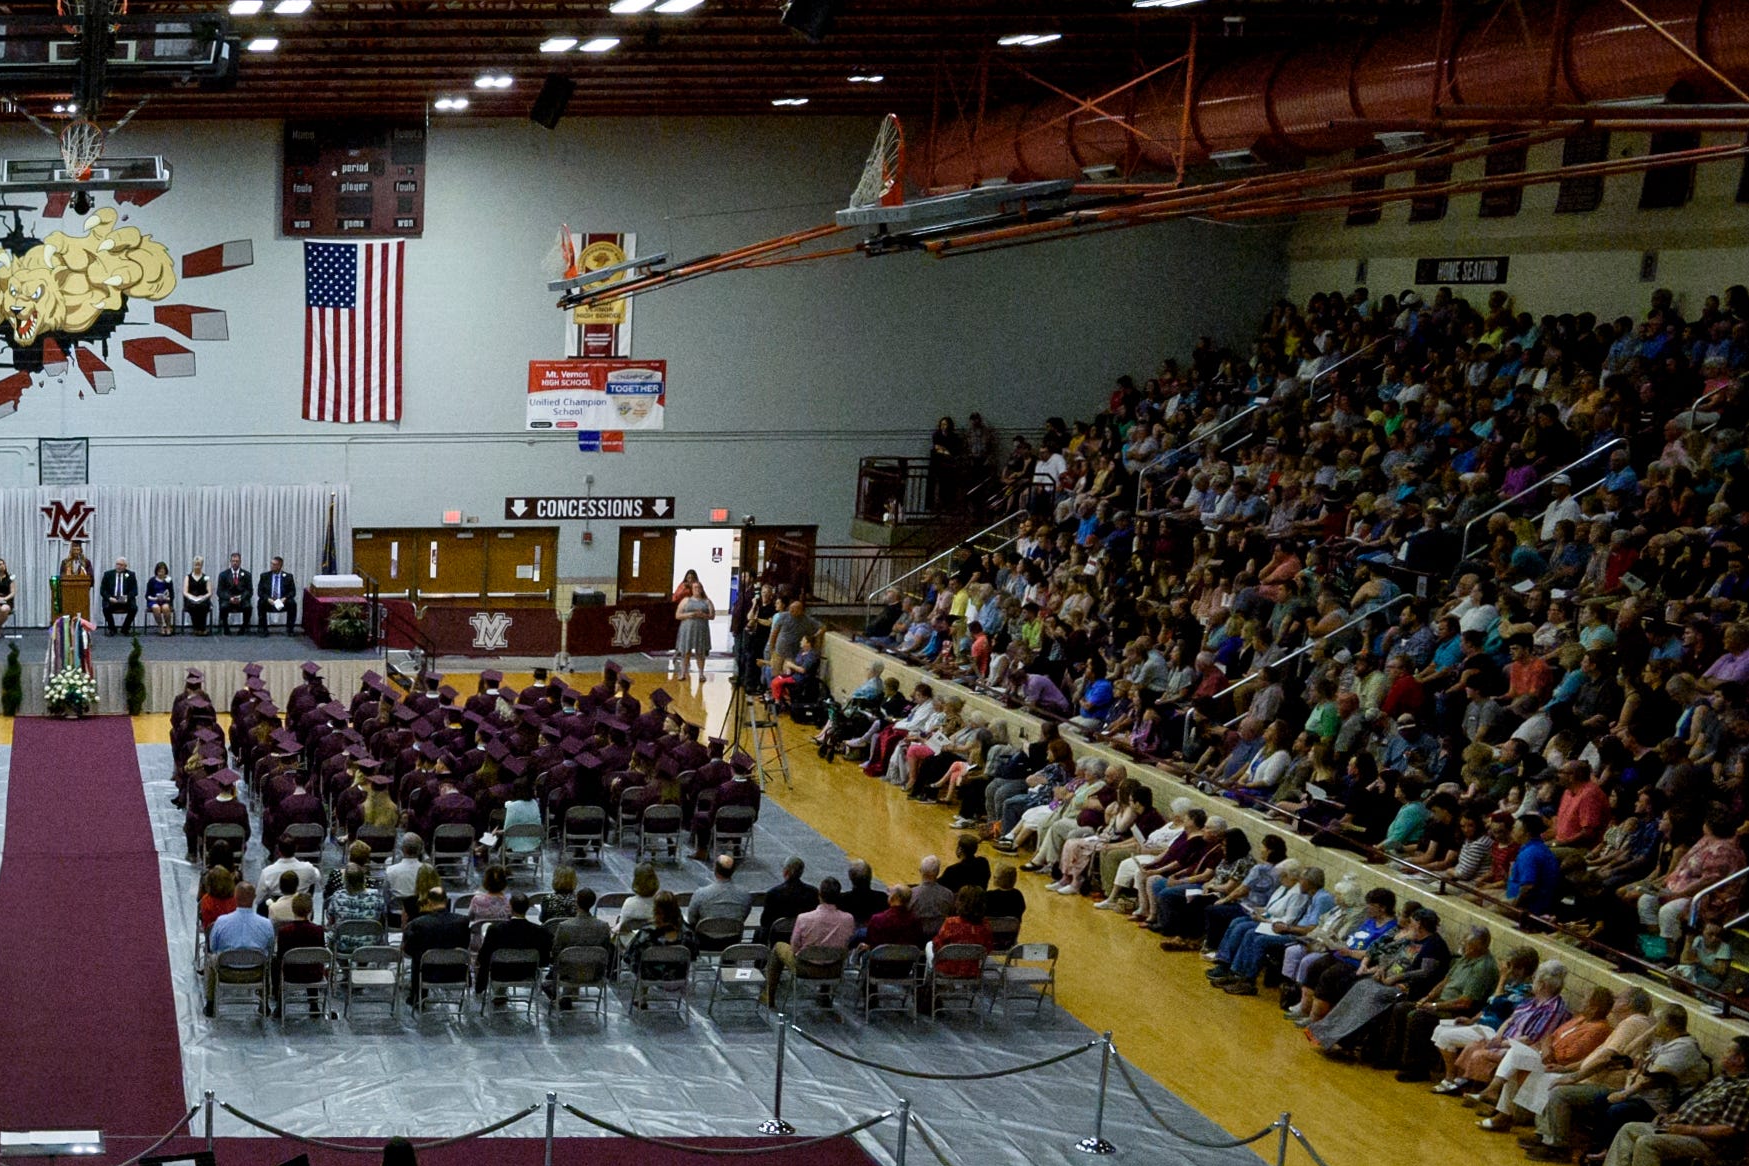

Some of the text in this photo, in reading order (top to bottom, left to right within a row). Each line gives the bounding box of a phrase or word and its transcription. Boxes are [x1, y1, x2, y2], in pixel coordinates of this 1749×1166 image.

[341, 162, 369, 174] period
[293, 183, 313, 193] fouls
[341, 183, 368, 193] player
[396, 182, 416, 192] fouls
[293, 220, 311, 228] won
[343, 219, 365, 230] game
[397, 218, 413, 228] won
[1437, 259, 1499, 281] HOME SEATING
[610, 383, 660, 393] TOGETHER
[529, 397, 607, 408] Unified Champion
[553, 407, 583, 416] School
[537, 499, 643, 518] CONCESSIONS
